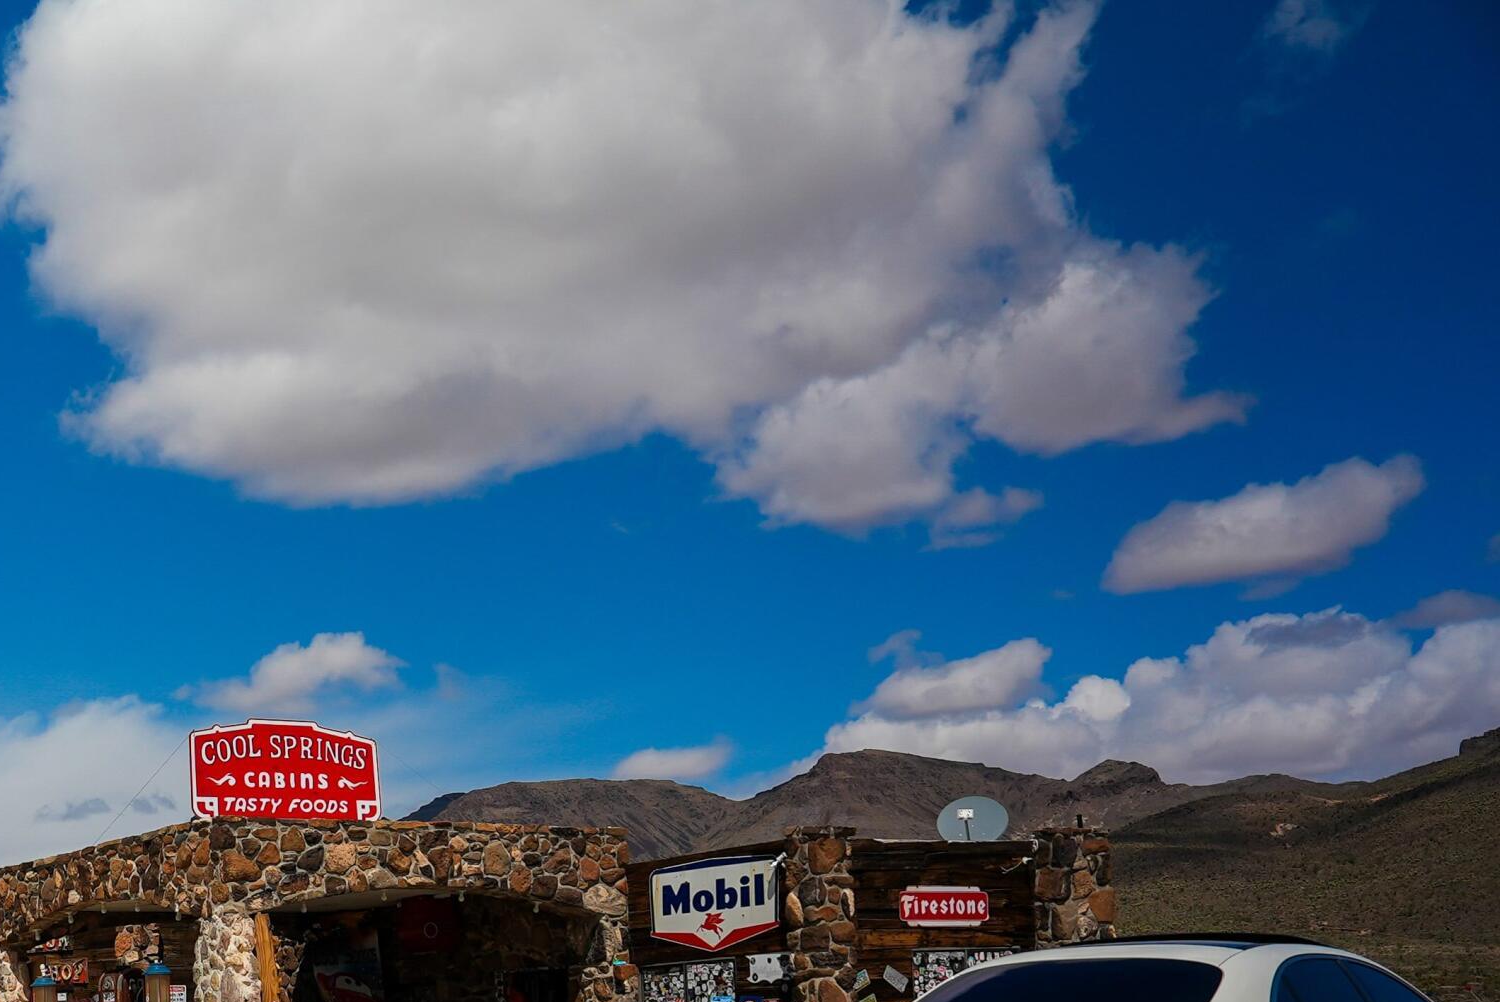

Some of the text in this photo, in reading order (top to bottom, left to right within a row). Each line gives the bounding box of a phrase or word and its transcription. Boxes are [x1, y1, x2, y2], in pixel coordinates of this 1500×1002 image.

[201, 734, 367, 770] COOL SPRINGS
[243, 771, 329, 790] CABINS
[223, 796, 349, 814] TASTY FOODS
[662, 873, 765, 917] Mobil
[901, 894, 987, 918] Firestone
